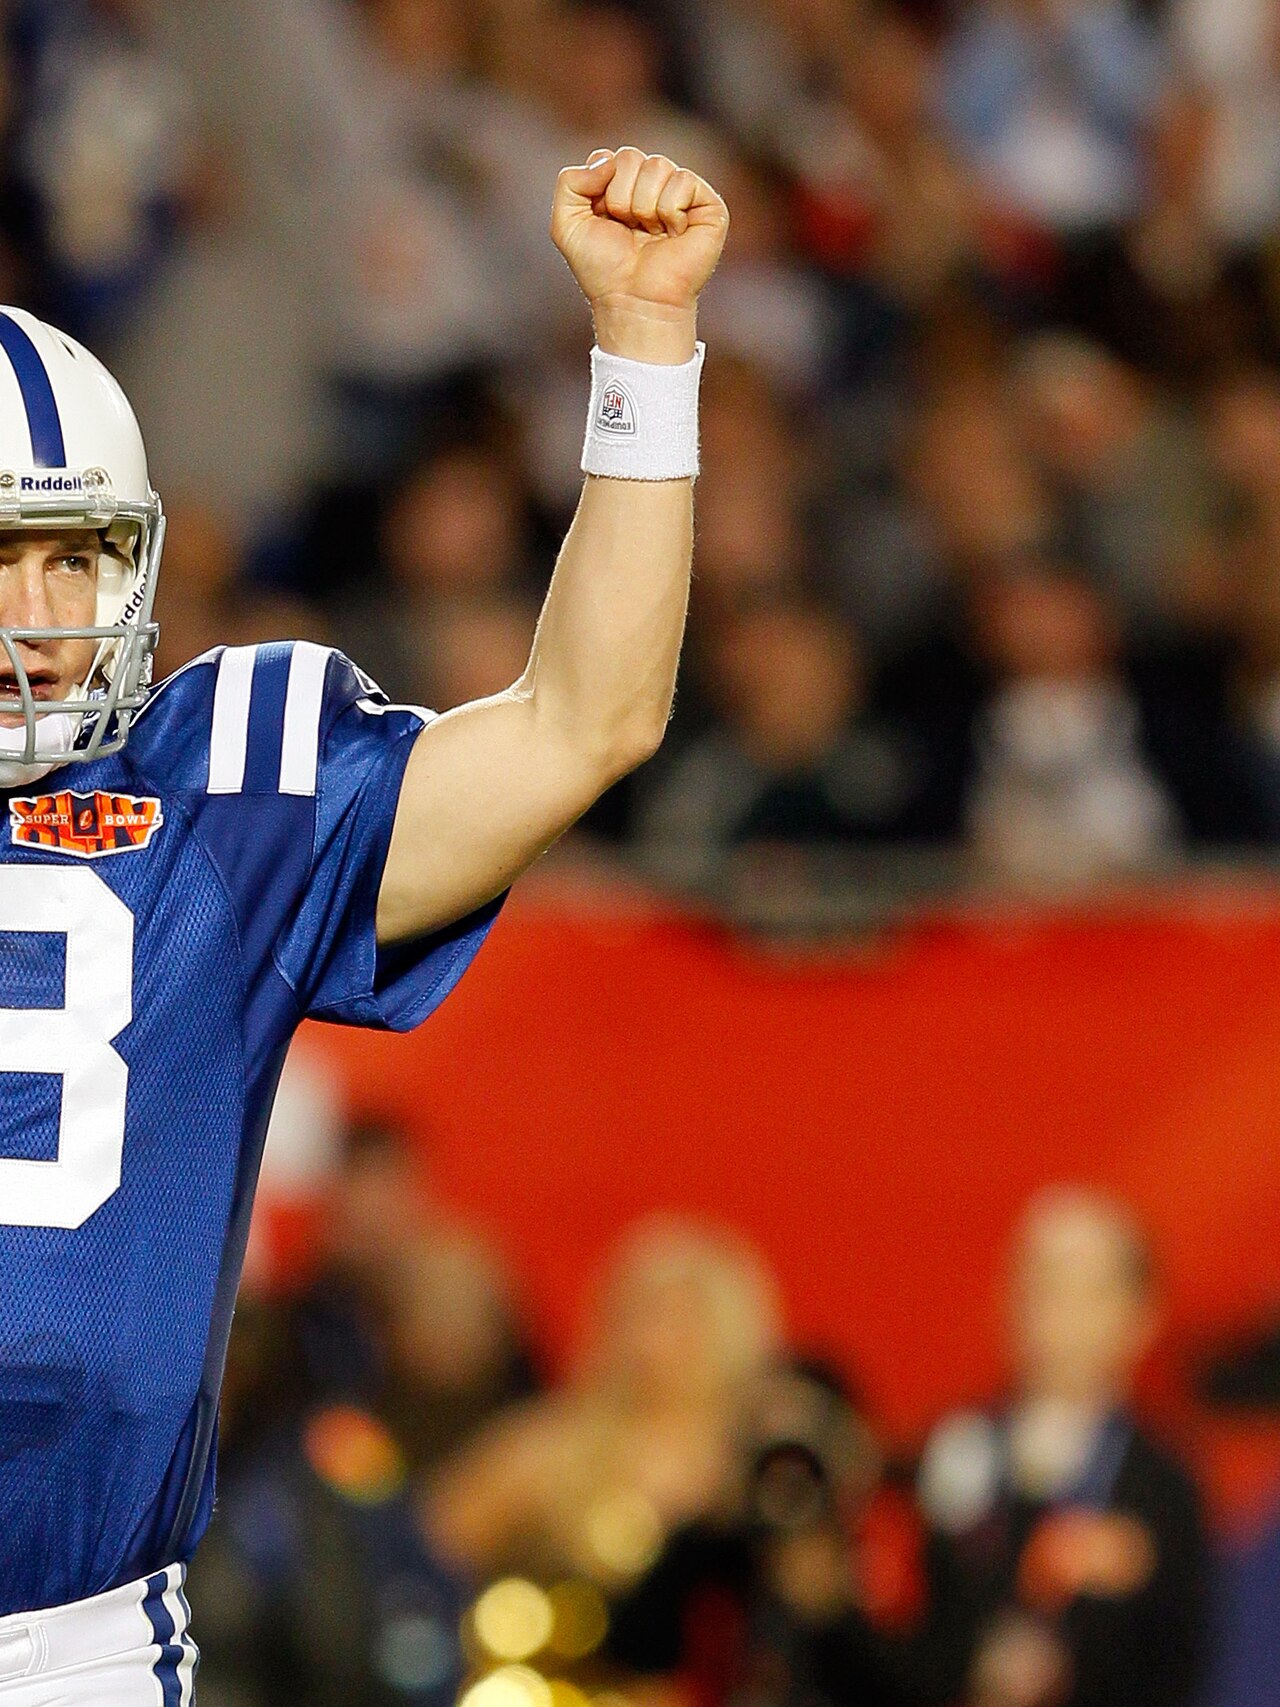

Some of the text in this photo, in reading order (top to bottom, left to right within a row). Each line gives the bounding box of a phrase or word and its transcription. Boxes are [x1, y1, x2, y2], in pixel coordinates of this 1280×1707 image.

[603, 394, 623, 410] NFL
[20, 476, 82, 490] Riddell
[24, 813, 149, 825] SUPER BOWL
